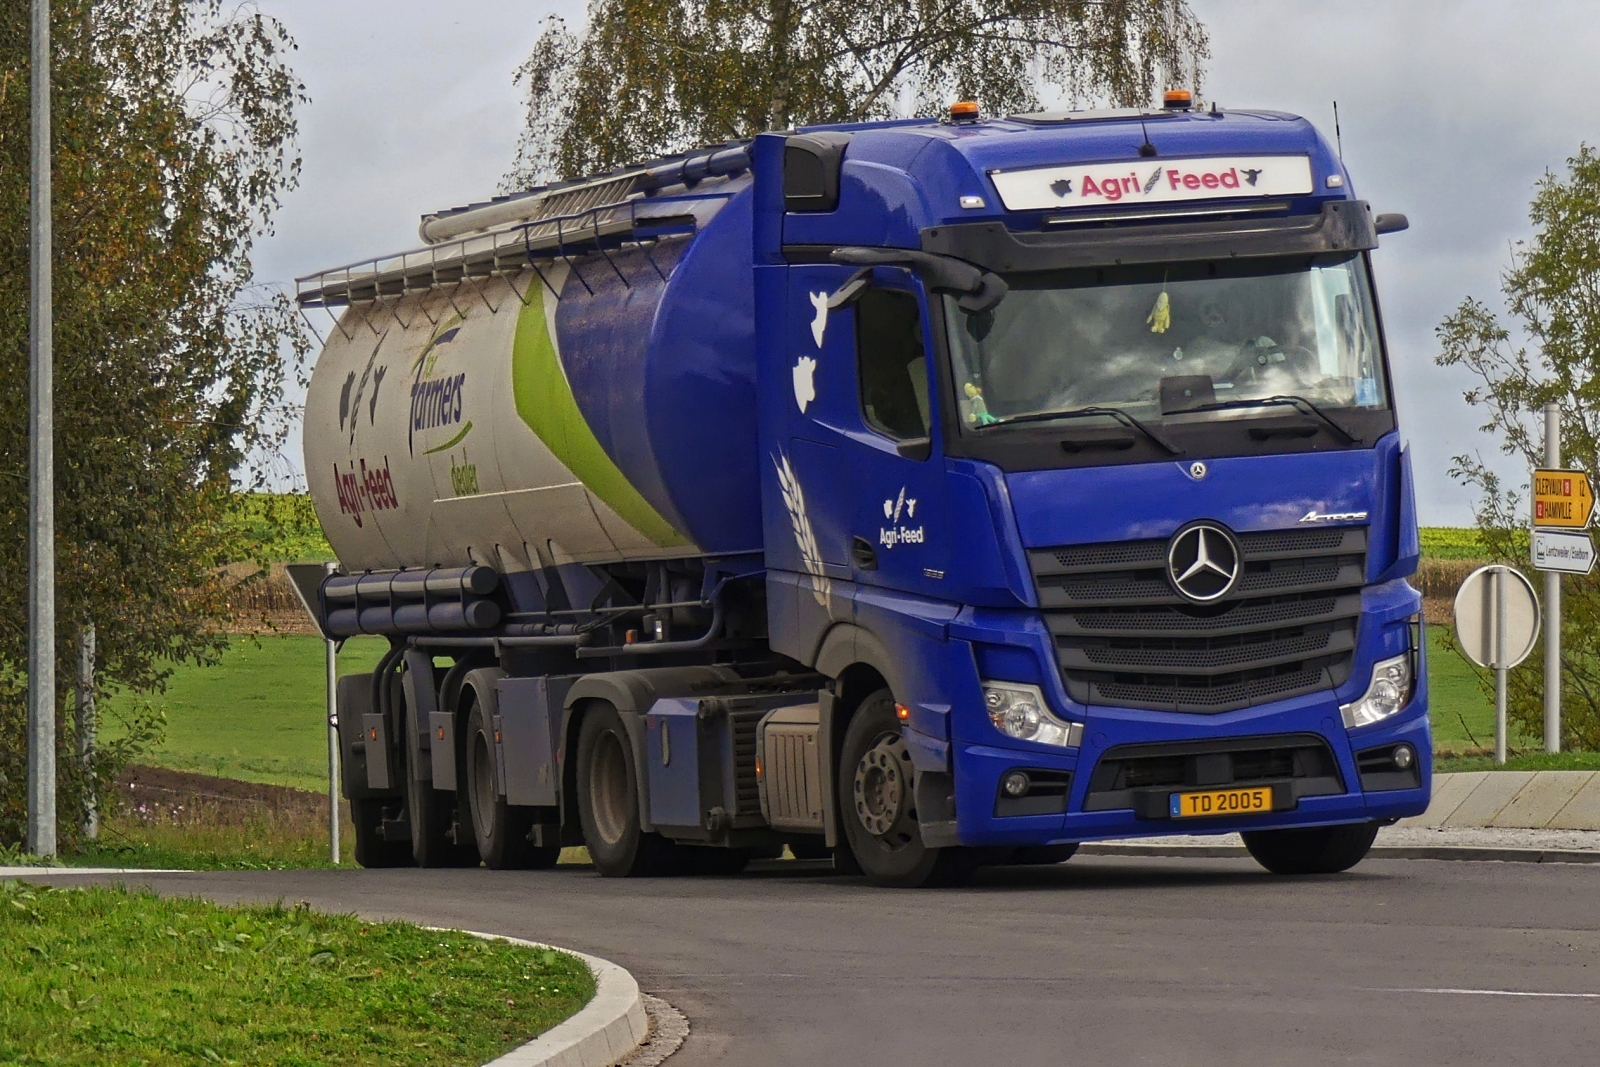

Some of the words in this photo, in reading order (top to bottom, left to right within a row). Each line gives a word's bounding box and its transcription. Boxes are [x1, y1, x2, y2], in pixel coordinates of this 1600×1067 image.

[1081, 172, 1140, 201] Agri
[1166, 166, 1241, 192] Feed
[333, 455, 399, 529] Agri-Feed
[1536, 478, 1562, 496] CLERVAUX
[1580, 479, 1585, 497] 12
[880, 526, 924, 549] Agri-Feed
[1173, 806, 1179, 814] L
[1189, 795, 1212, 813] TD
[1217, 791, 1263, 812] 2005
